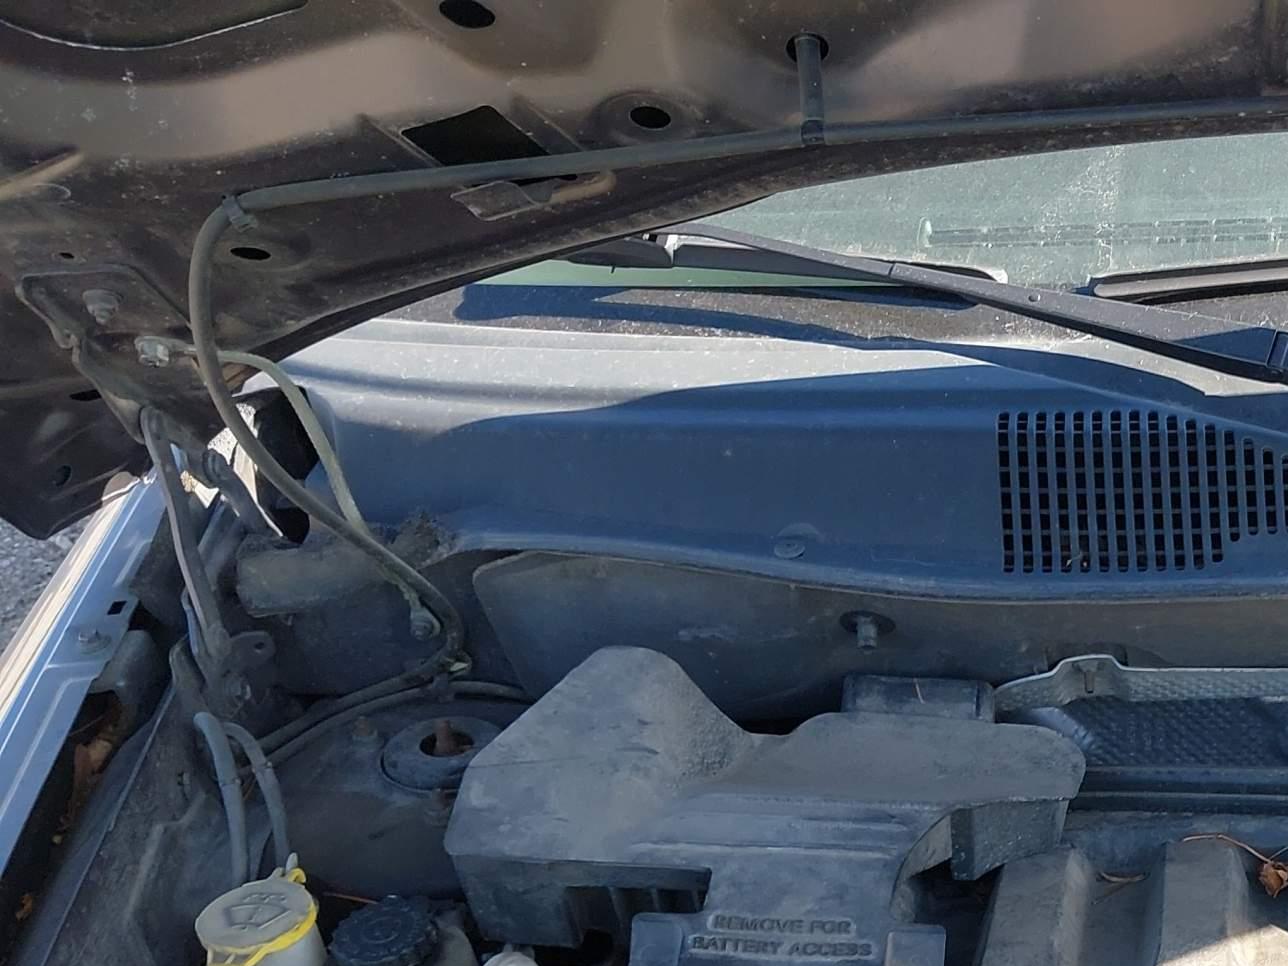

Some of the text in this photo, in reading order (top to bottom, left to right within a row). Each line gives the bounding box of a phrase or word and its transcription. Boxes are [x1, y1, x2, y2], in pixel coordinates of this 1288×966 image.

[713, 914, 852, 935] REMOVE FOR
[692, 936, 873, 957] BATTERY ACCESS
